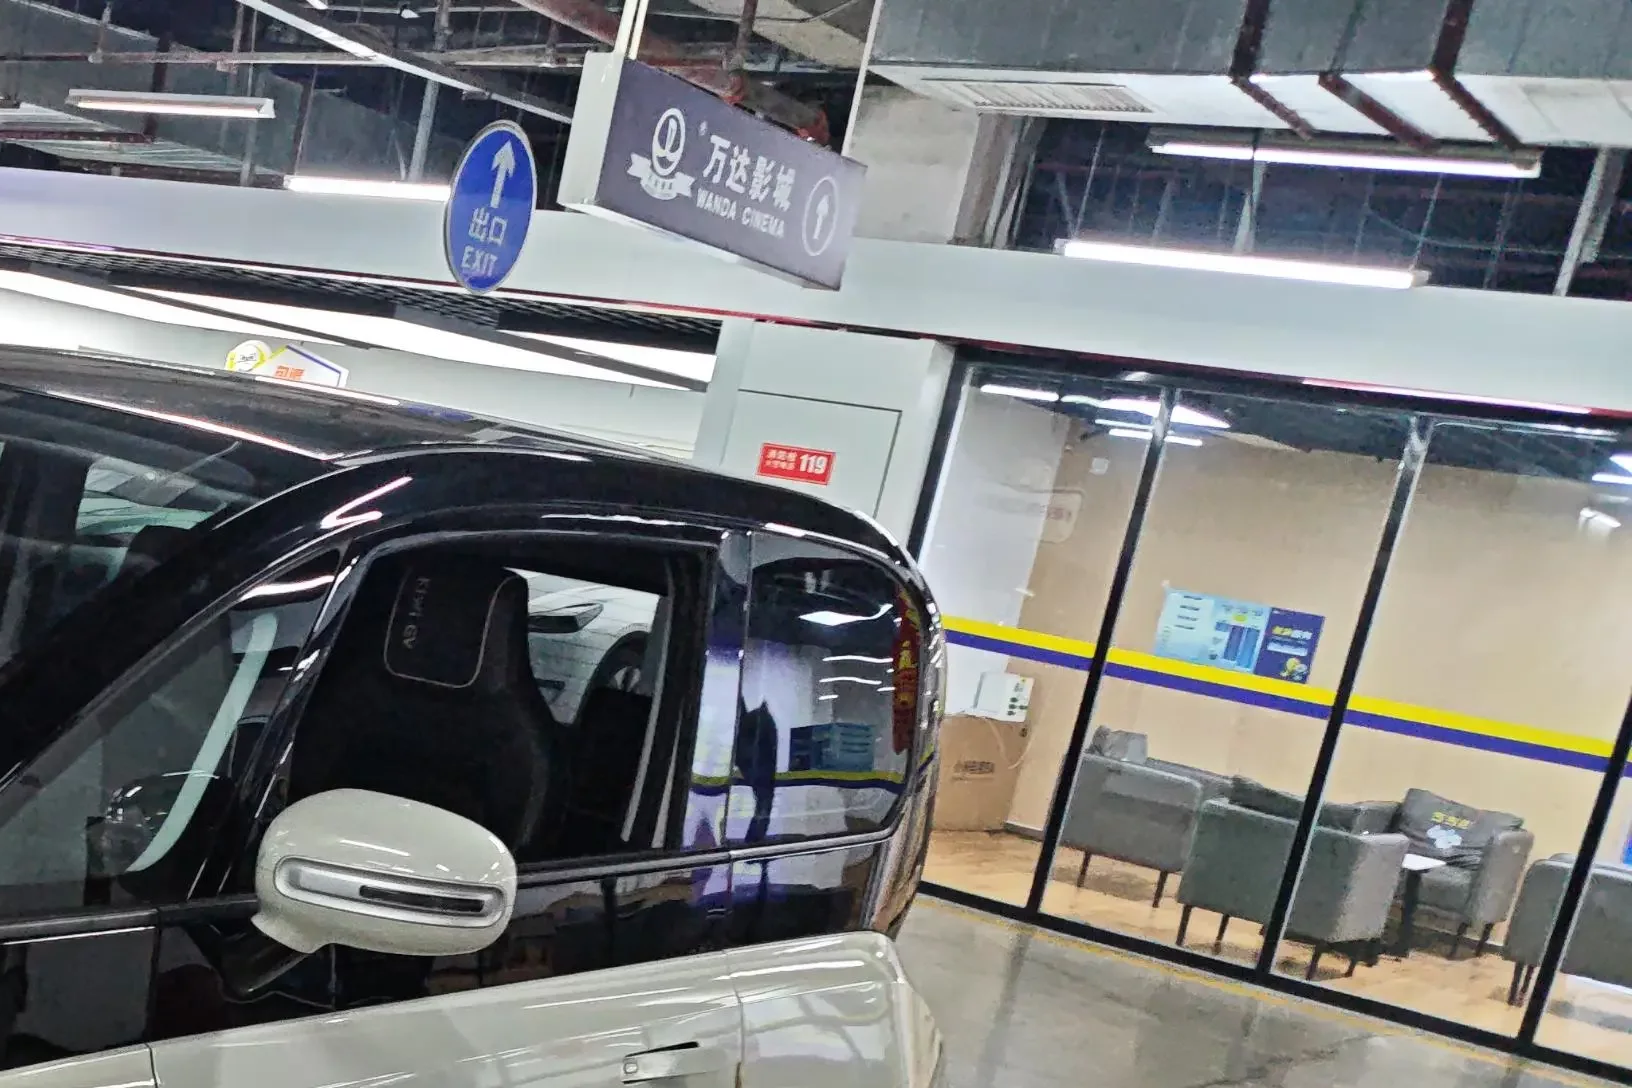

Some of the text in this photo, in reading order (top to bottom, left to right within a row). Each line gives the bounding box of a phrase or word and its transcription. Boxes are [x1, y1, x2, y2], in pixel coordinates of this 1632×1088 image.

[702, 134, 796, 212] 万达影城
[468, 207, 508, 246] 出口
[696, 188, 785, 239] WANDA CINEMA
[461, 245, 498, 277] EXIT
[799, 454, 828, 475] 119
